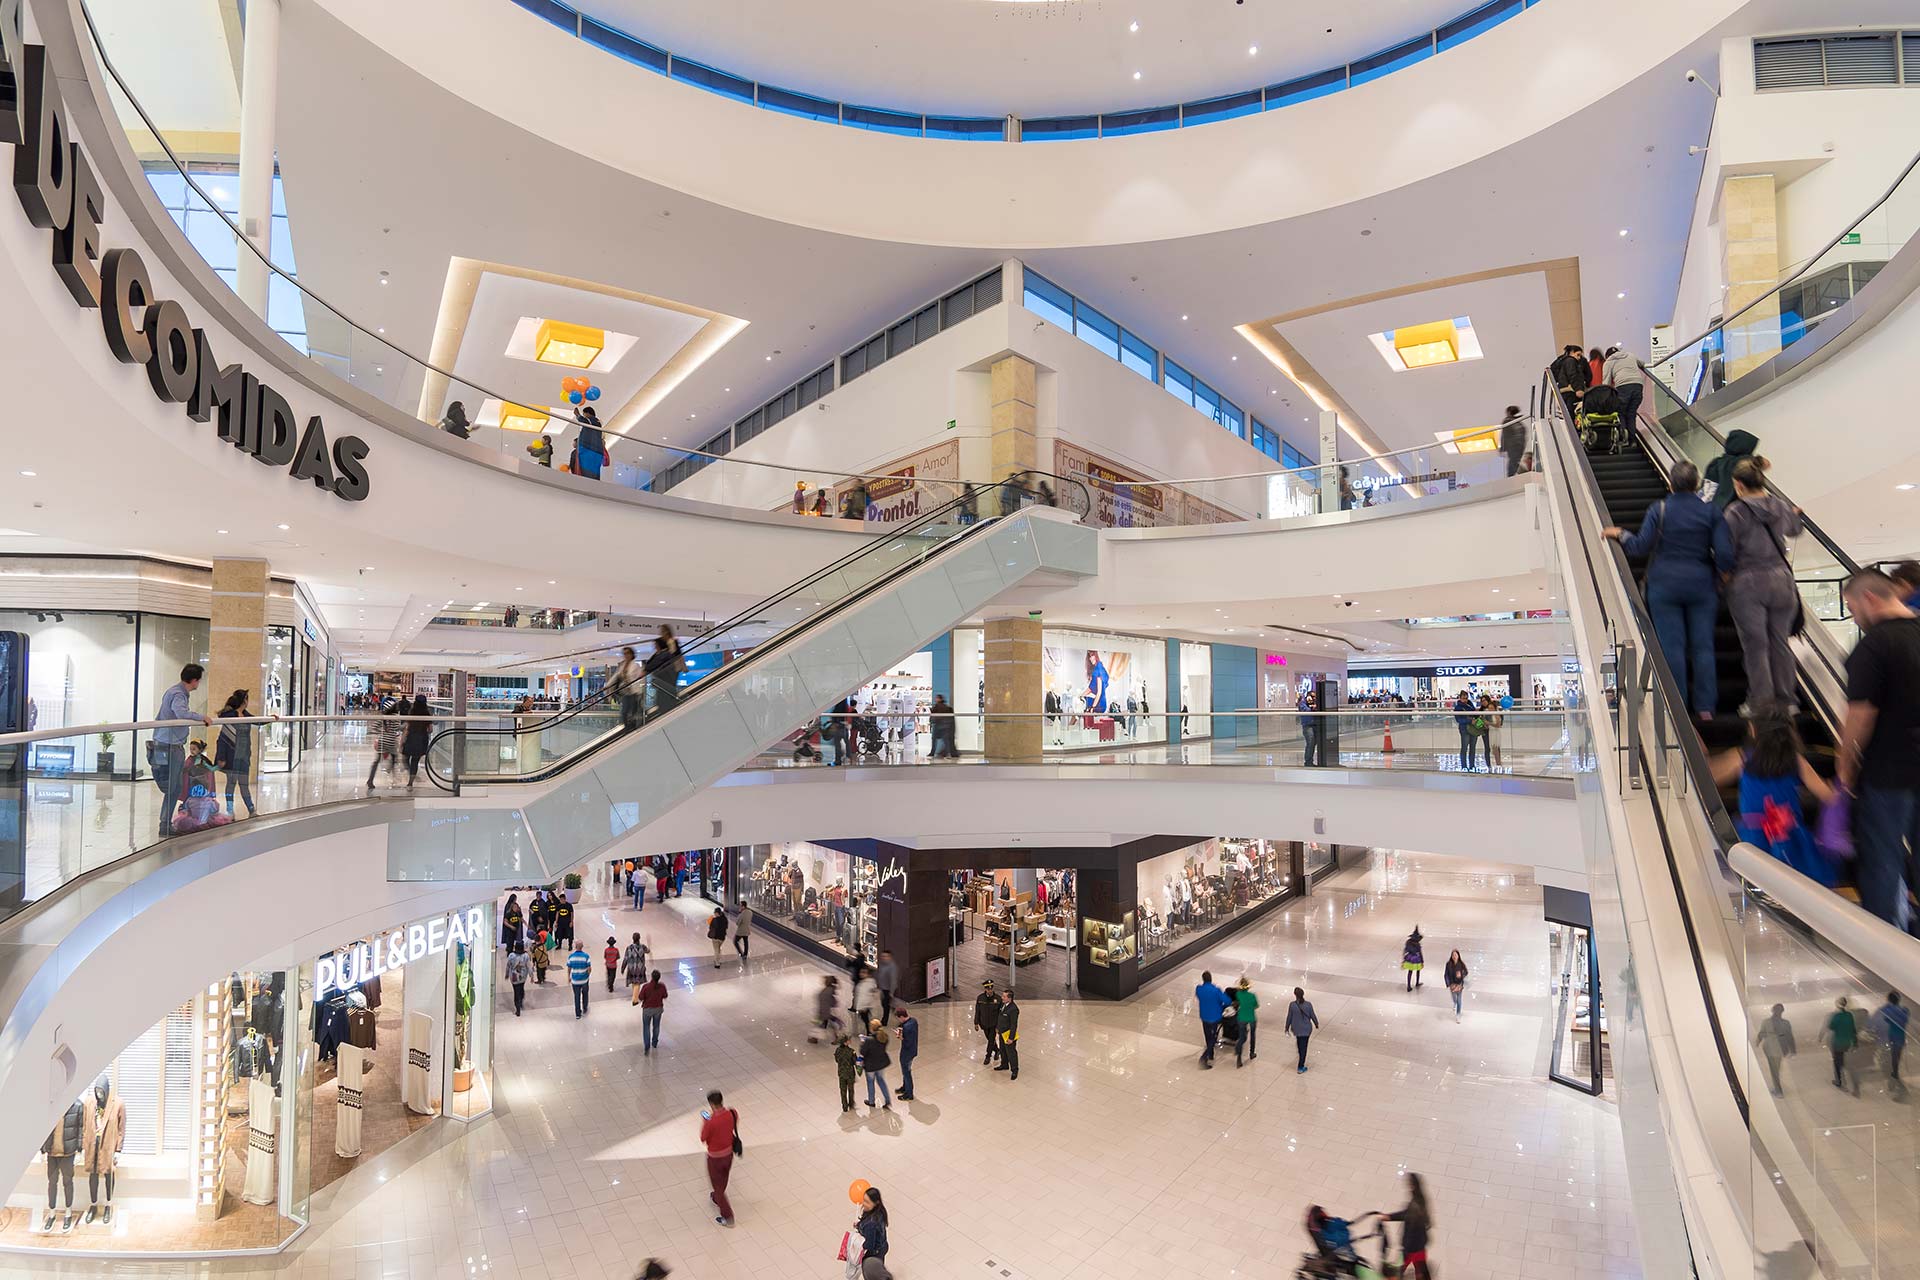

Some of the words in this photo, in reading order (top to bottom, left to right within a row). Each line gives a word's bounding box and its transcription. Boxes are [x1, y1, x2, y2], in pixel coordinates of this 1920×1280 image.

[13, 44, 105, 308] DE
[101, 248, 371, 503] COMIDAS
[1652, 337, 1659, 345] 3
[922, 454, 951, 473] Amor
[1436, 667, 1475, 676] STUDIO
[1476, 666, 1485, 675] F
[314, 908, 484, 1001] PULL&BEAR
